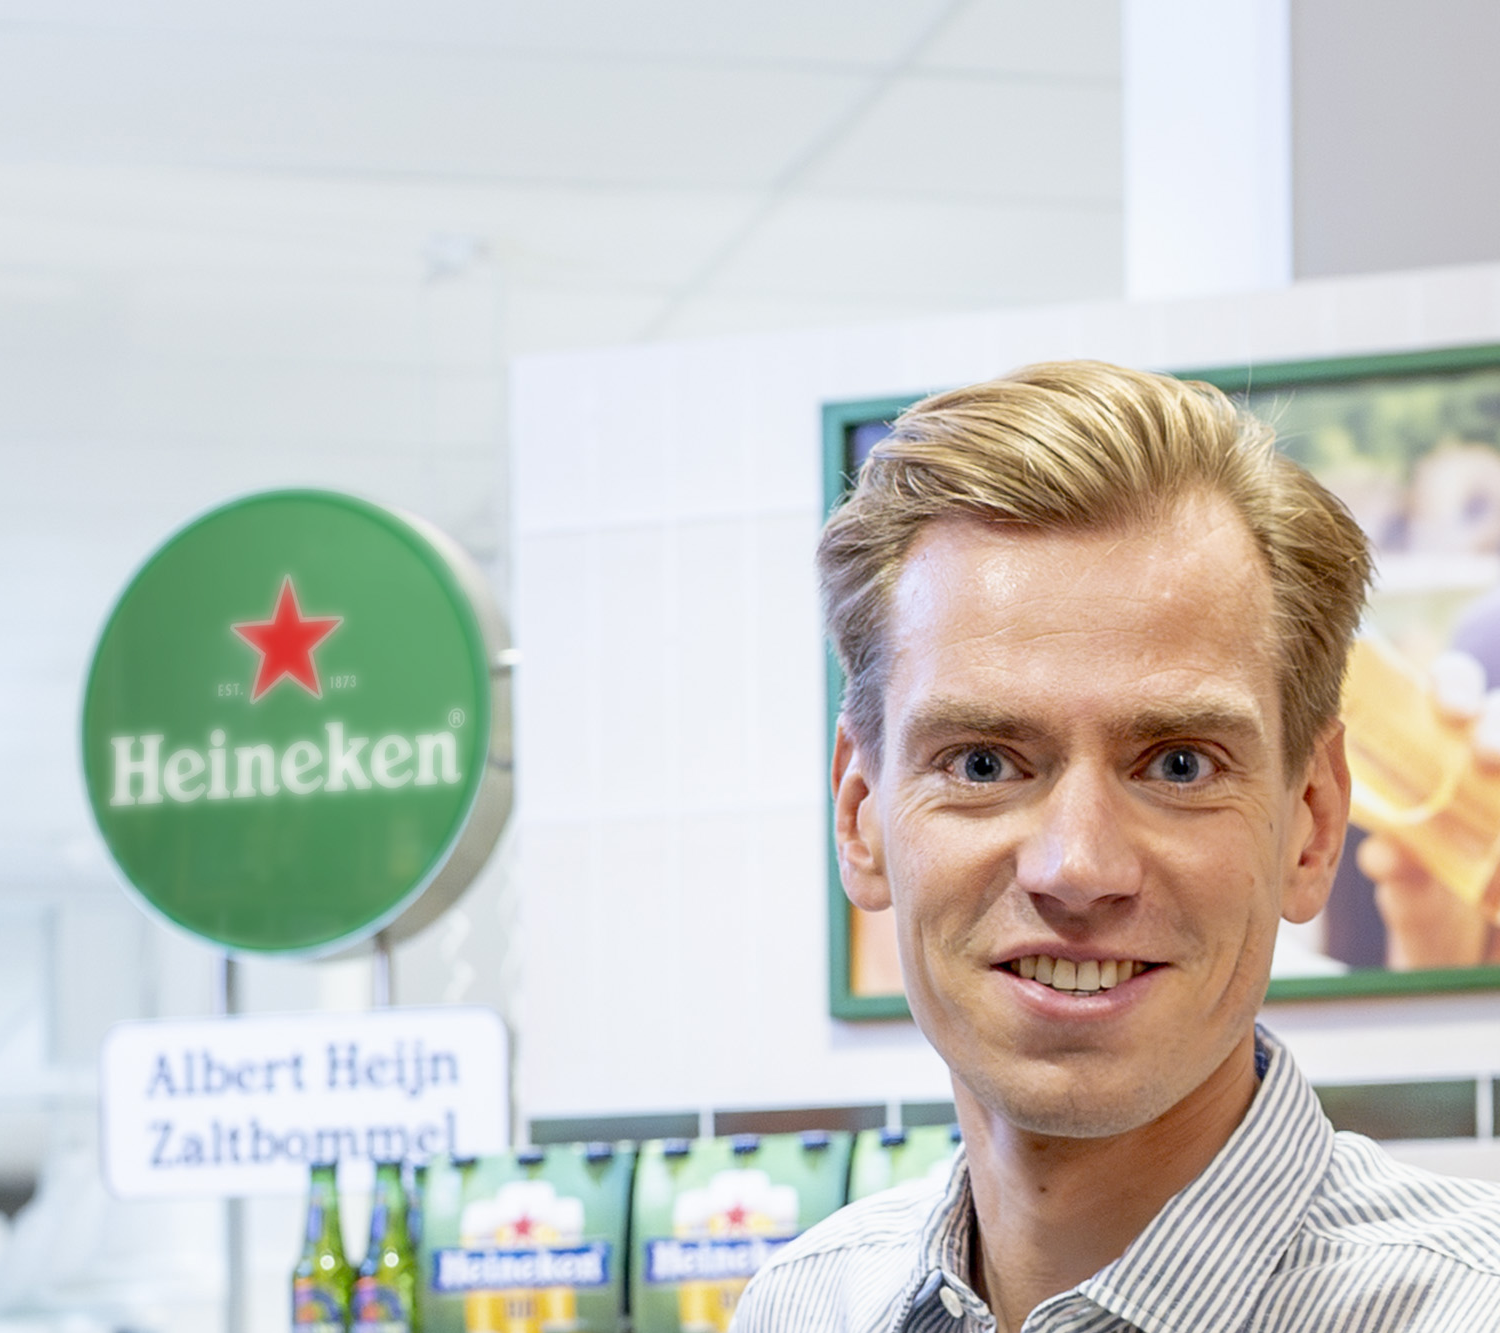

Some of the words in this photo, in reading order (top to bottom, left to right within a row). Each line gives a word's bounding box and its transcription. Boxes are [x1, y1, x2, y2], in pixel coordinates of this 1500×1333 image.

[217, 683, 245, 697] EST.
[329, 674, 357, 689] 1873
[111, 722, 461, 806] Heineken
[147, 1050, 304, 1098] Albert
[326, 1041, 460, 1096] Heijn
[149, 1110, 457, 1168] Zaltbommel
